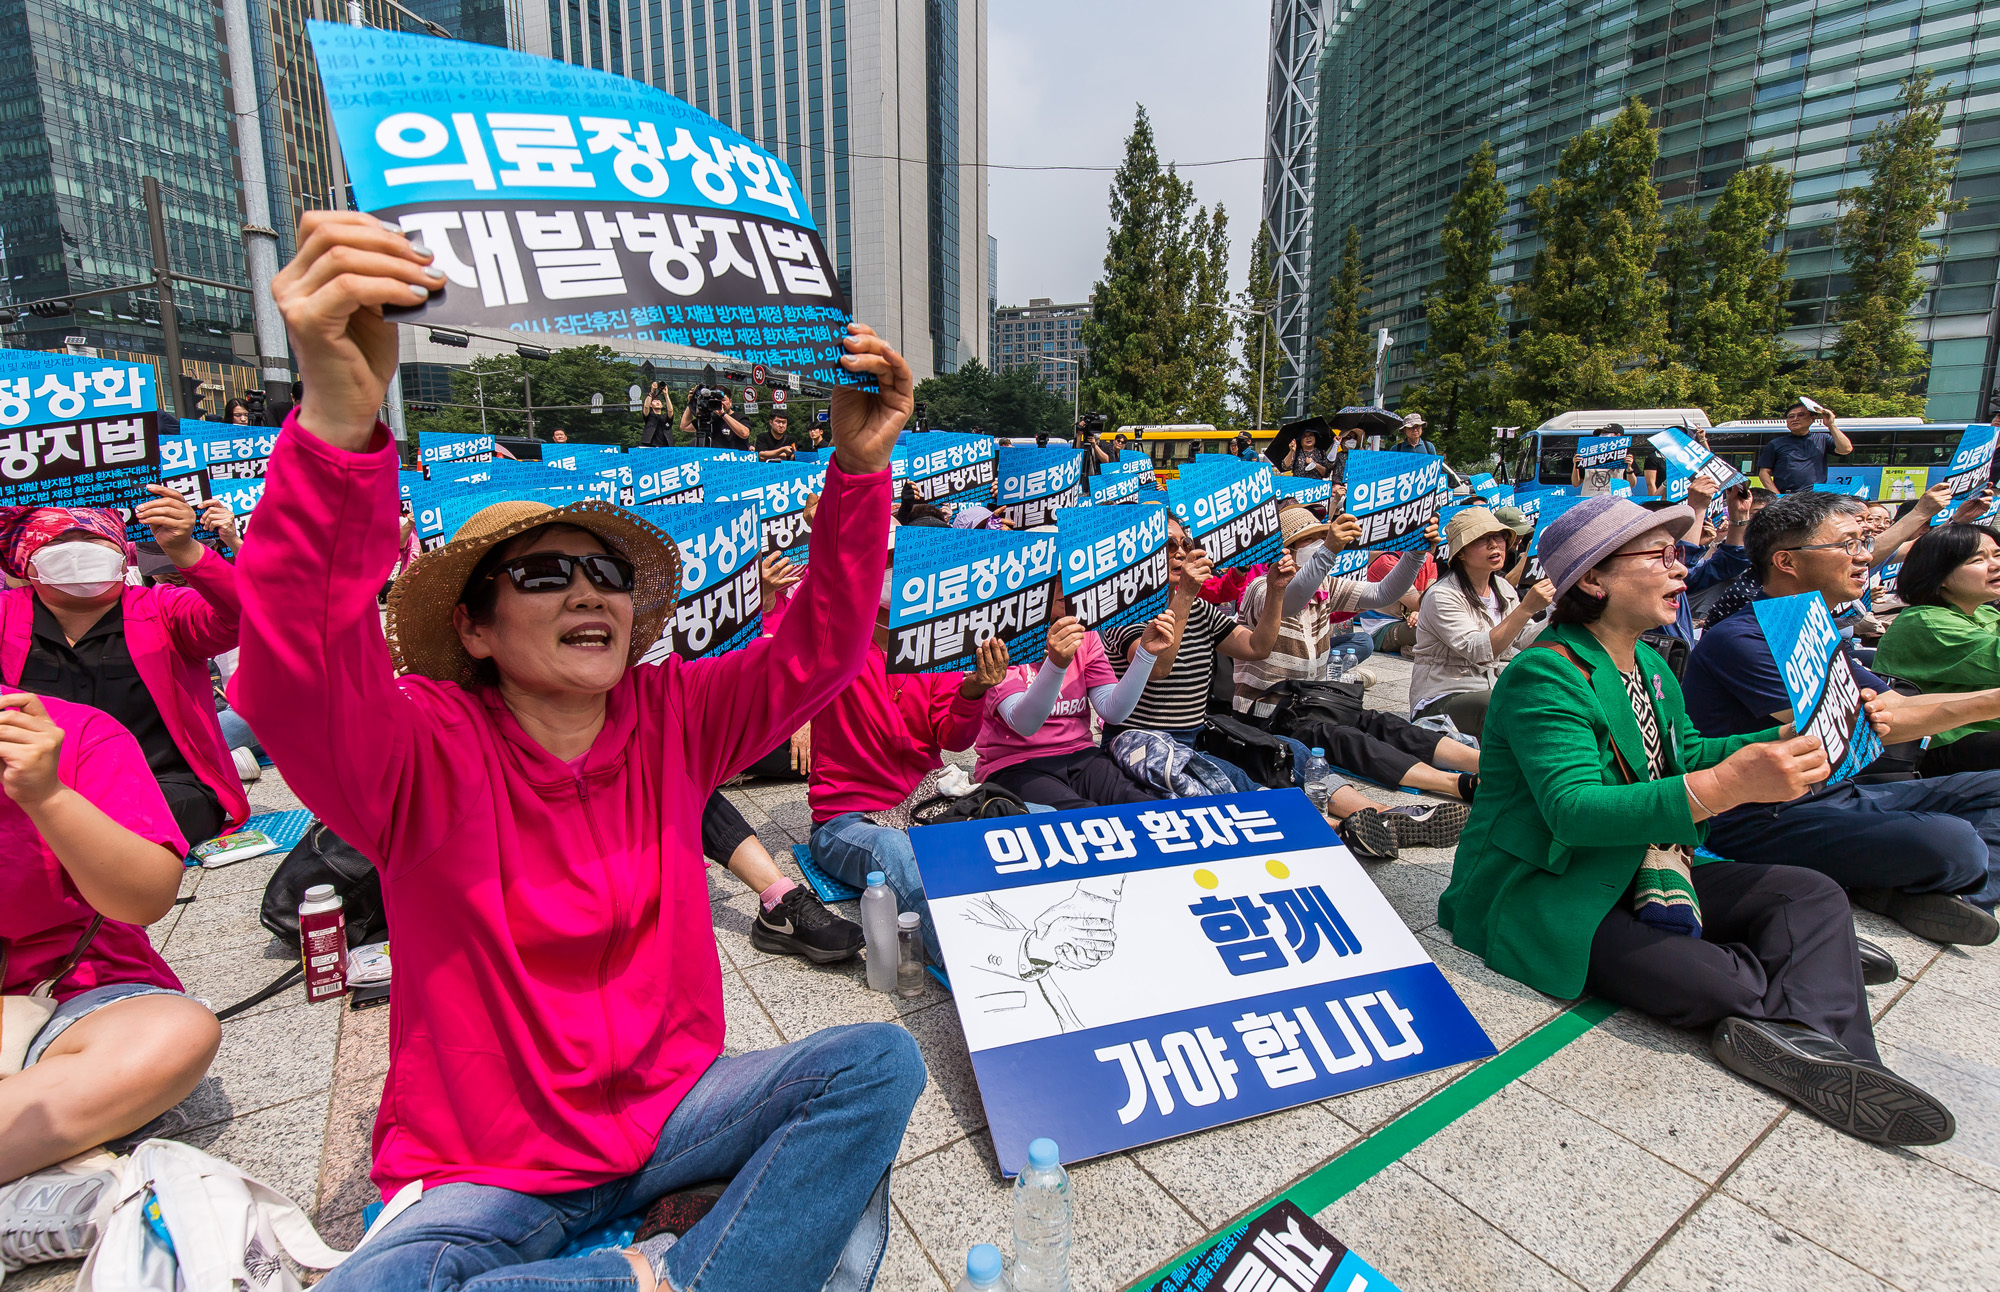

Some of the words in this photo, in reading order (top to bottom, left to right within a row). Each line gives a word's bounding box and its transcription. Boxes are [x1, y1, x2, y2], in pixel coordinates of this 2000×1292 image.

[375, 111, 800, 220] 의료정상화
[398, 210, 833, 309] 재발방지법
[554, 309, 629, 336] 집단휴진
[630, 305, 666, 328] 철회
[666, 305, 685, 324] 및
[685, 304, 716, 324] 재발
[717, 305, 756, 325] 방지법
[756, 305, 783, 324] 제정
[783, 305, 845, 325] 환자촉구대회
[691, 326, 735, 347] 방지법
[735, 326, 763, 346] 제정
[762, 325, 832, 347] 환자촉구대회
[755, 370, 763, 380] 50
[775, 391, 784, 400] 50
[425, 436, 492, 462] 의료정상화
[913, 438, 992, 477] 의료정상화
[1578, 448, 1628, 468] 재발방지법
[1579, 436, 1630, 456] 의료정상화
[918, 461, 993, 501] 재발방지법
[1094, 475, 1139, 505] 의료정상화
[1193, 466, 1273, 528] 의료정상화
[1353, 459, 1440, 512] 의료정상화
[1069, 508, 1166, 585] 의료정상화
[1200, 500, 1279, 564] 재발방지법
[899, 537, 1057, 617] 의료정상화
[1071, 547, 1168, 626] 재발방지법
[895, 583, 1050, 667] 재발방지법
[1785, 596, 1836, 714] 의료정상화
[983, 816, 1137, 875] 의사와
[1146, 803, 1285, 854] 환자는
[1188, 868, 1363, 977] 함께
[1094, 1026, 1240, 1125] 가야
[1231, 990, 1424, 1090] 합니다
